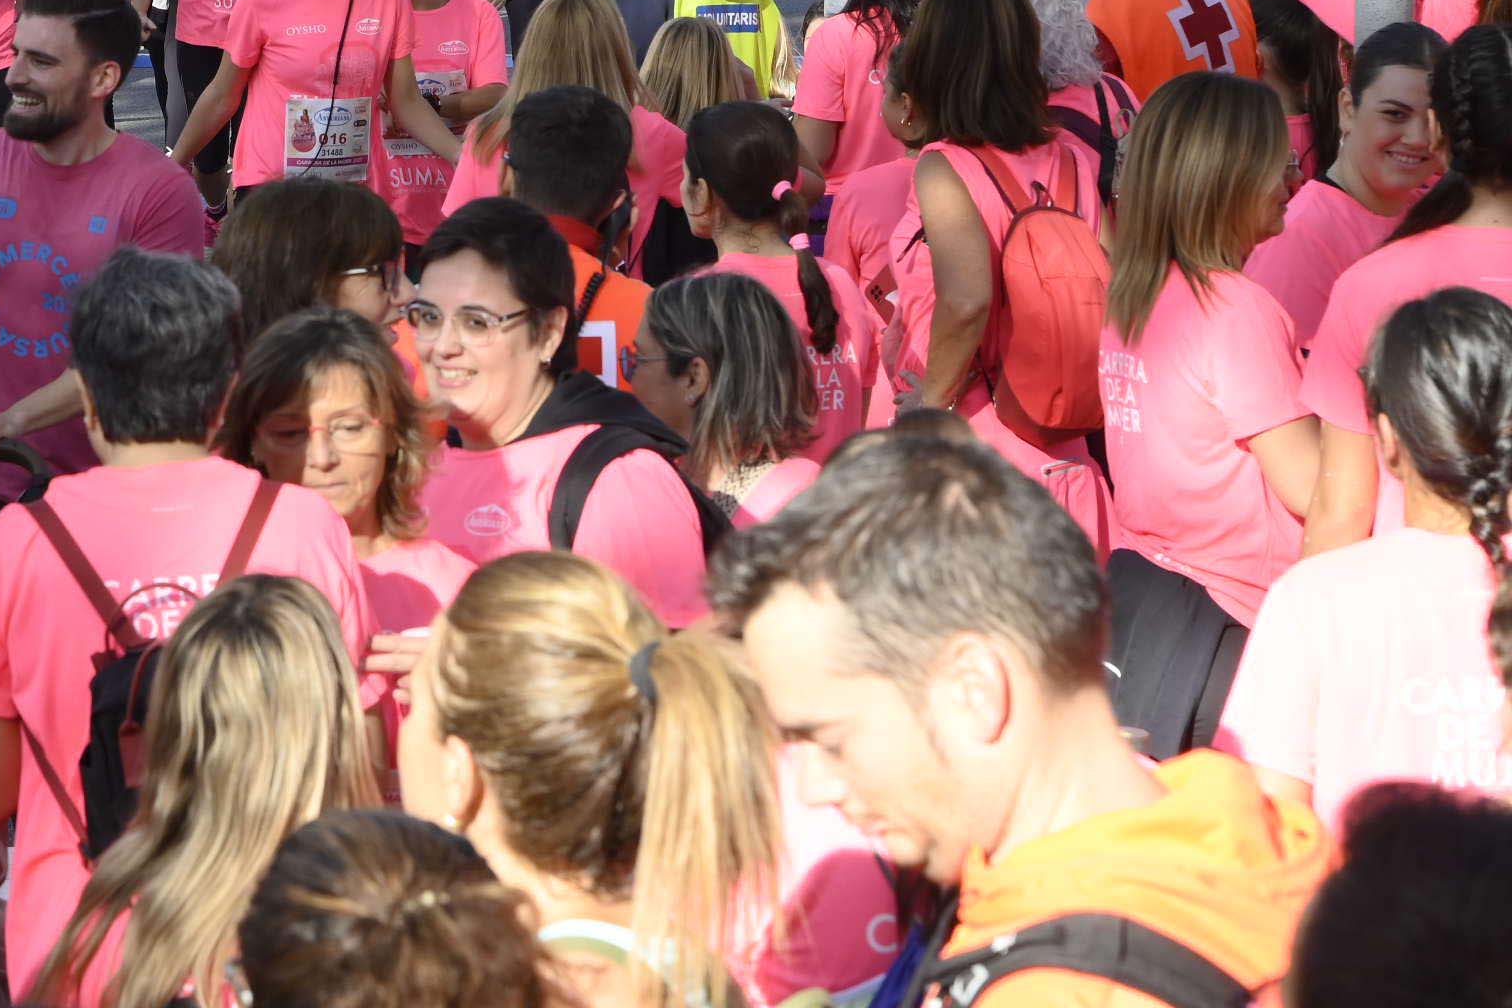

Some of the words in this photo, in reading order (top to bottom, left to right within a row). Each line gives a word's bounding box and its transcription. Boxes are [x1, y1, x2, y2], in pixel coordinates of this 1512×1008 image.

[285, 24, 327, 36] OYSHO
[318, 132, 348, 146] 016
[390, 141, 419, 151] OYSHO
[390, 167, 448, 188] SUMA
